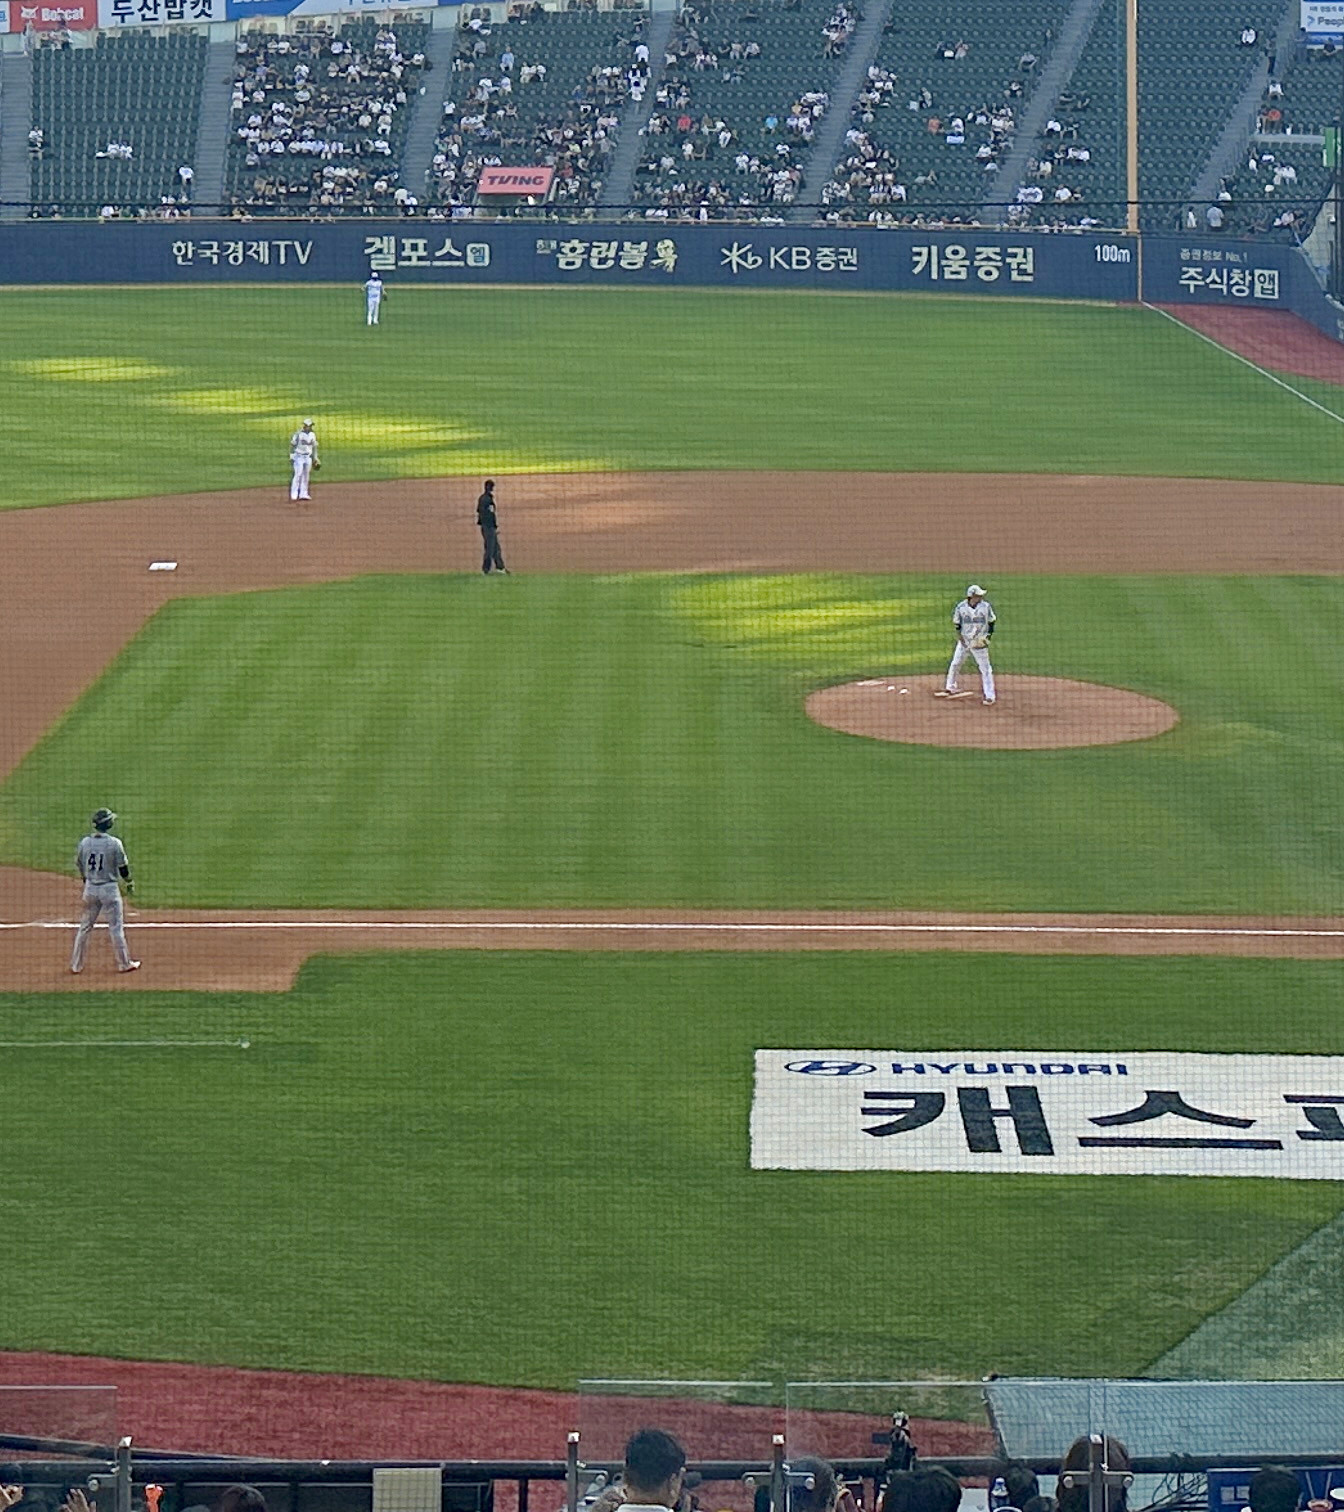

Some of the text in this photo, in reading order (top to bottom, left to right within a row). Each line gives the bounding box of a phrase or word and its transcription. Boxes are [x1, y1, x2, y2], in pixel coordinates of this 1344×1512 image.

[487, 175, 545, 186] TVING
[172, 240, 312, 266] 한국경제TV
[1094, 245, 1130, 263] 100m
[911, 245, 1034, 282] 키움증권
[87, 853, 103, 872] 41
[891, 1062, 1129, 1076] HYUNDAI
